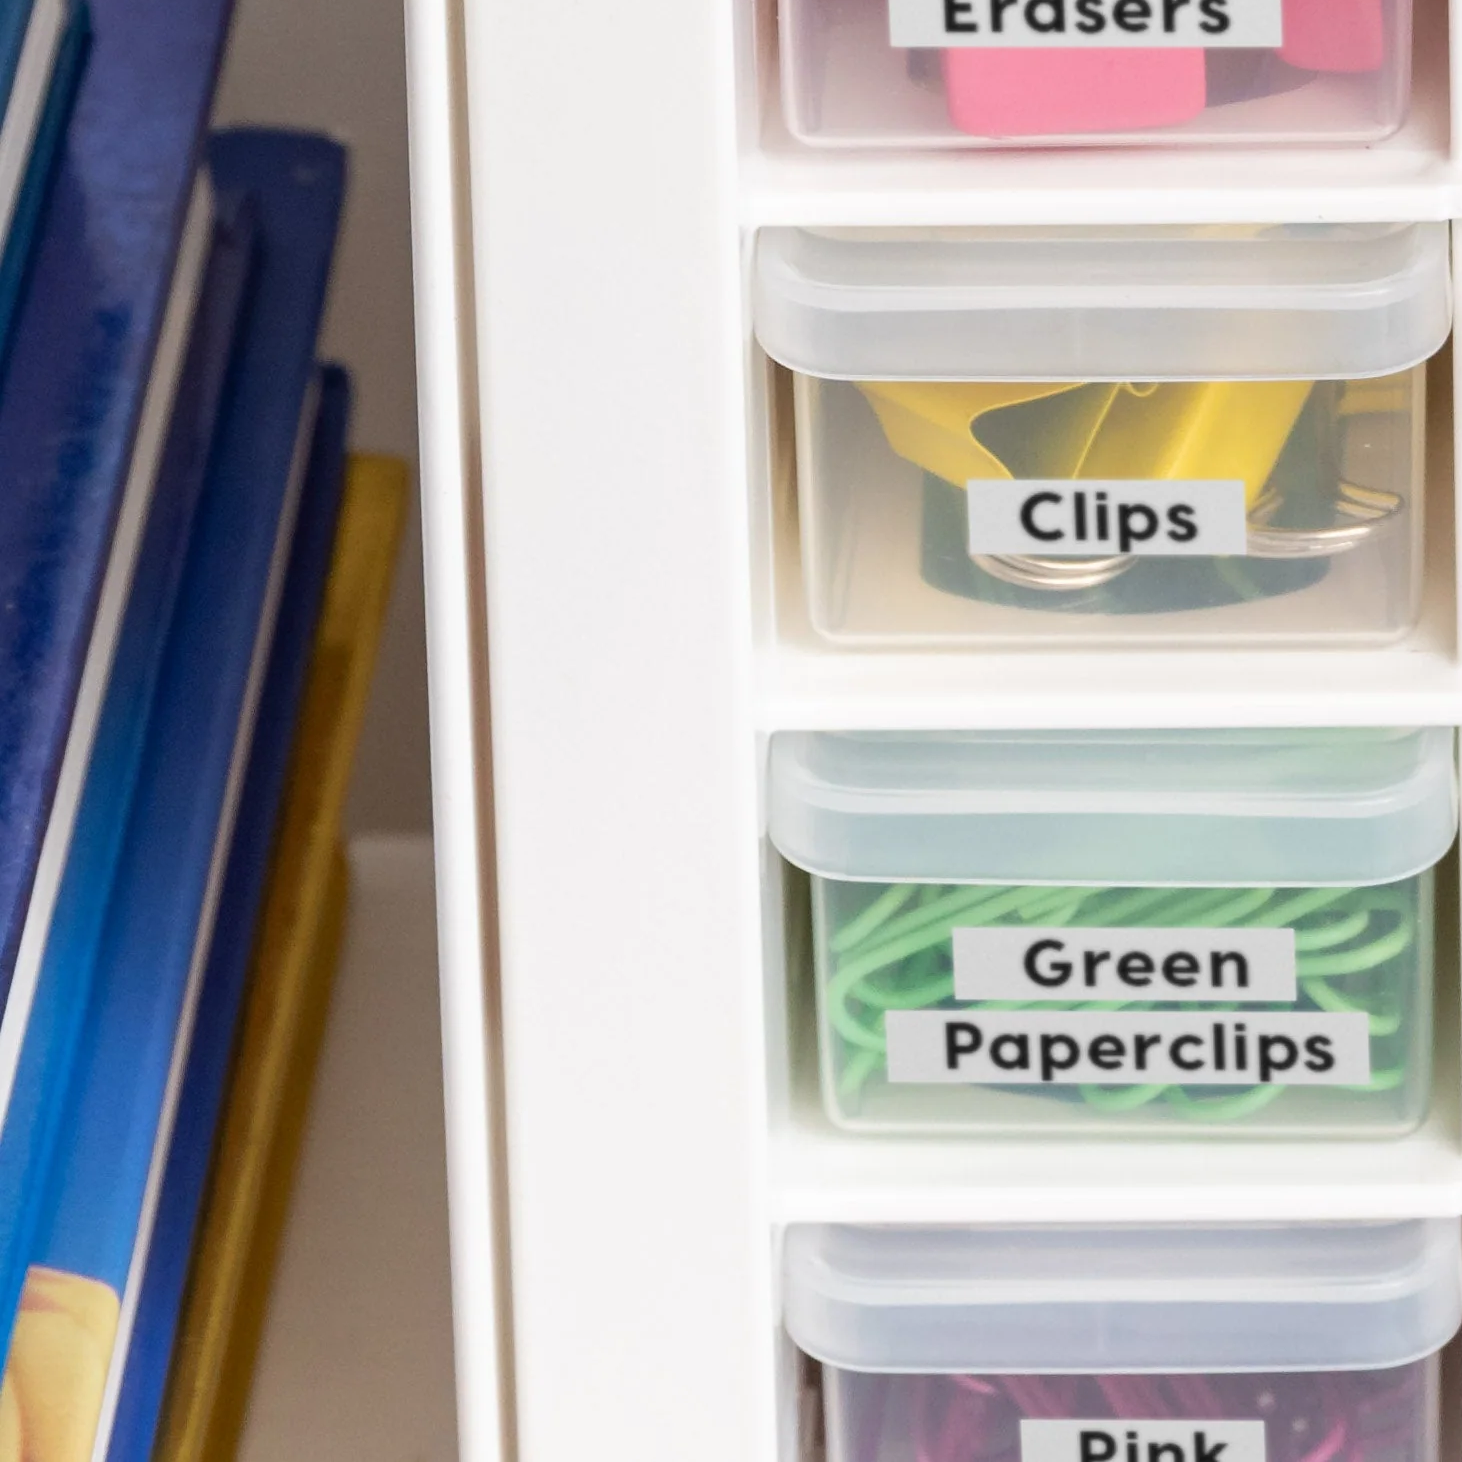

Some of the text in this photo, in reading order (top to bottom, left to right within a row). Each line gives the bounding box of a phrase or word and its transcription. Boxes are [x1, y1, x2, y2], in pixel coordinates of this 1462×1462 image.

[1018, 489, 1200, 555] Clips
[1021, 937, 1251, 990] Green
[943, 1019, 1337, 1085] Paperclips
[1078, 1428, 1229, 1462] Pink
